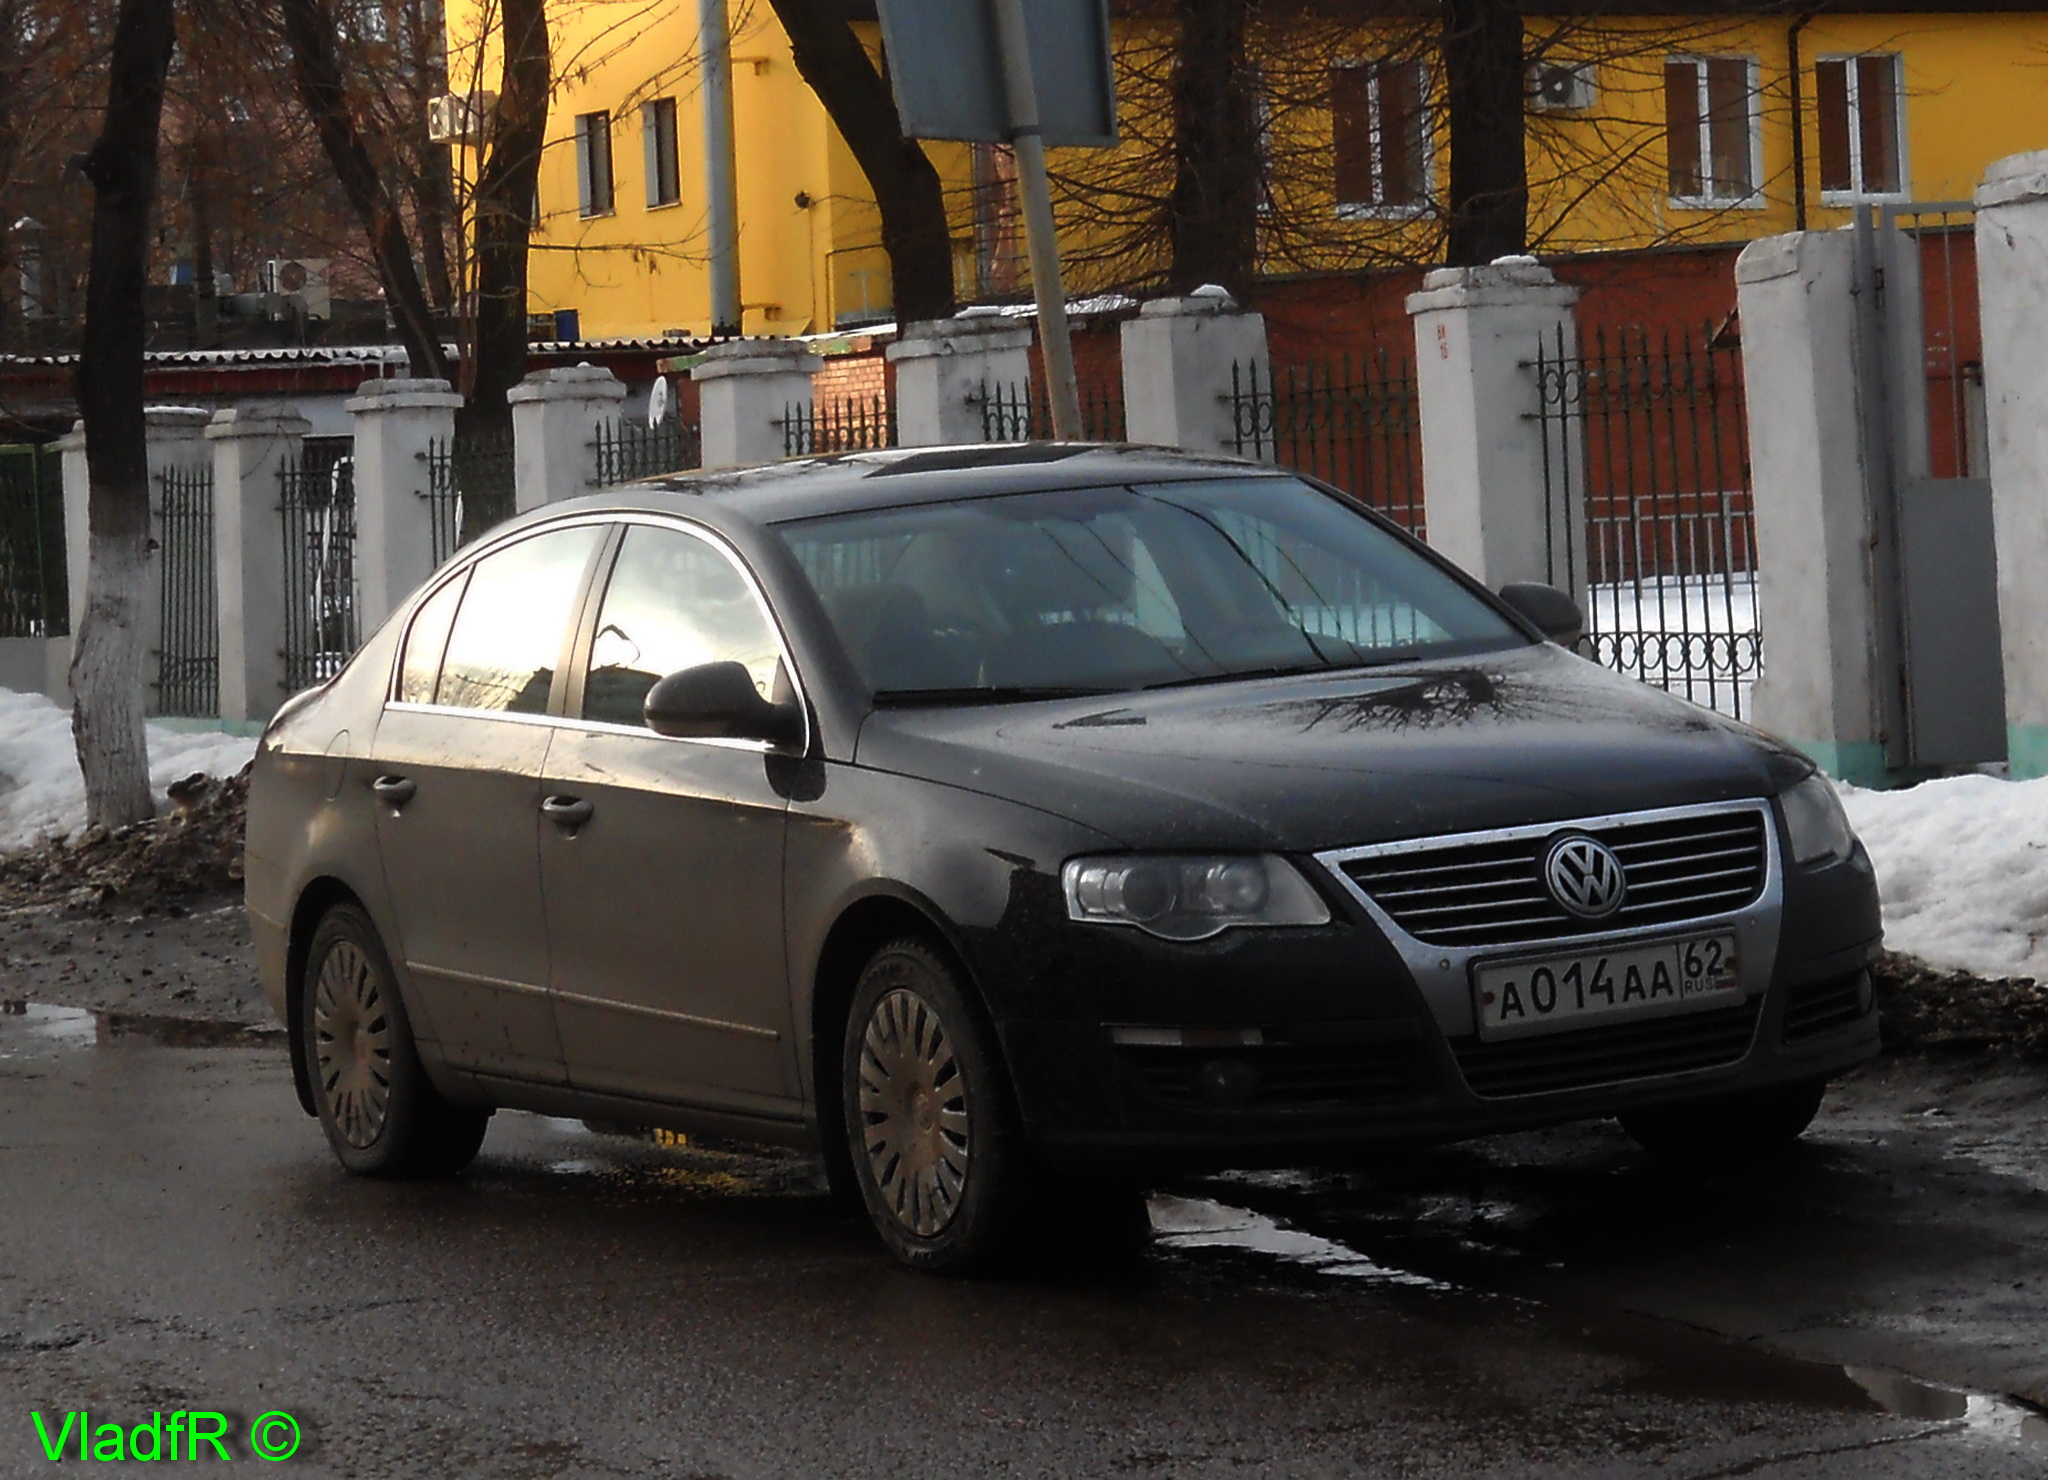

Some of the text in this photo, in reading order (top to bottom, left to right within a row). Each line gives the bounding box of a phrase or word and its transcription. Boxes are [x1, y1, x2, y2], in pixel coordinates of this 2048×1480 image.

[1549, 839, 1622, 914] VW
[1684, 939, 1724, 978] 62
[1684, 978, 1714, 993] RUS
